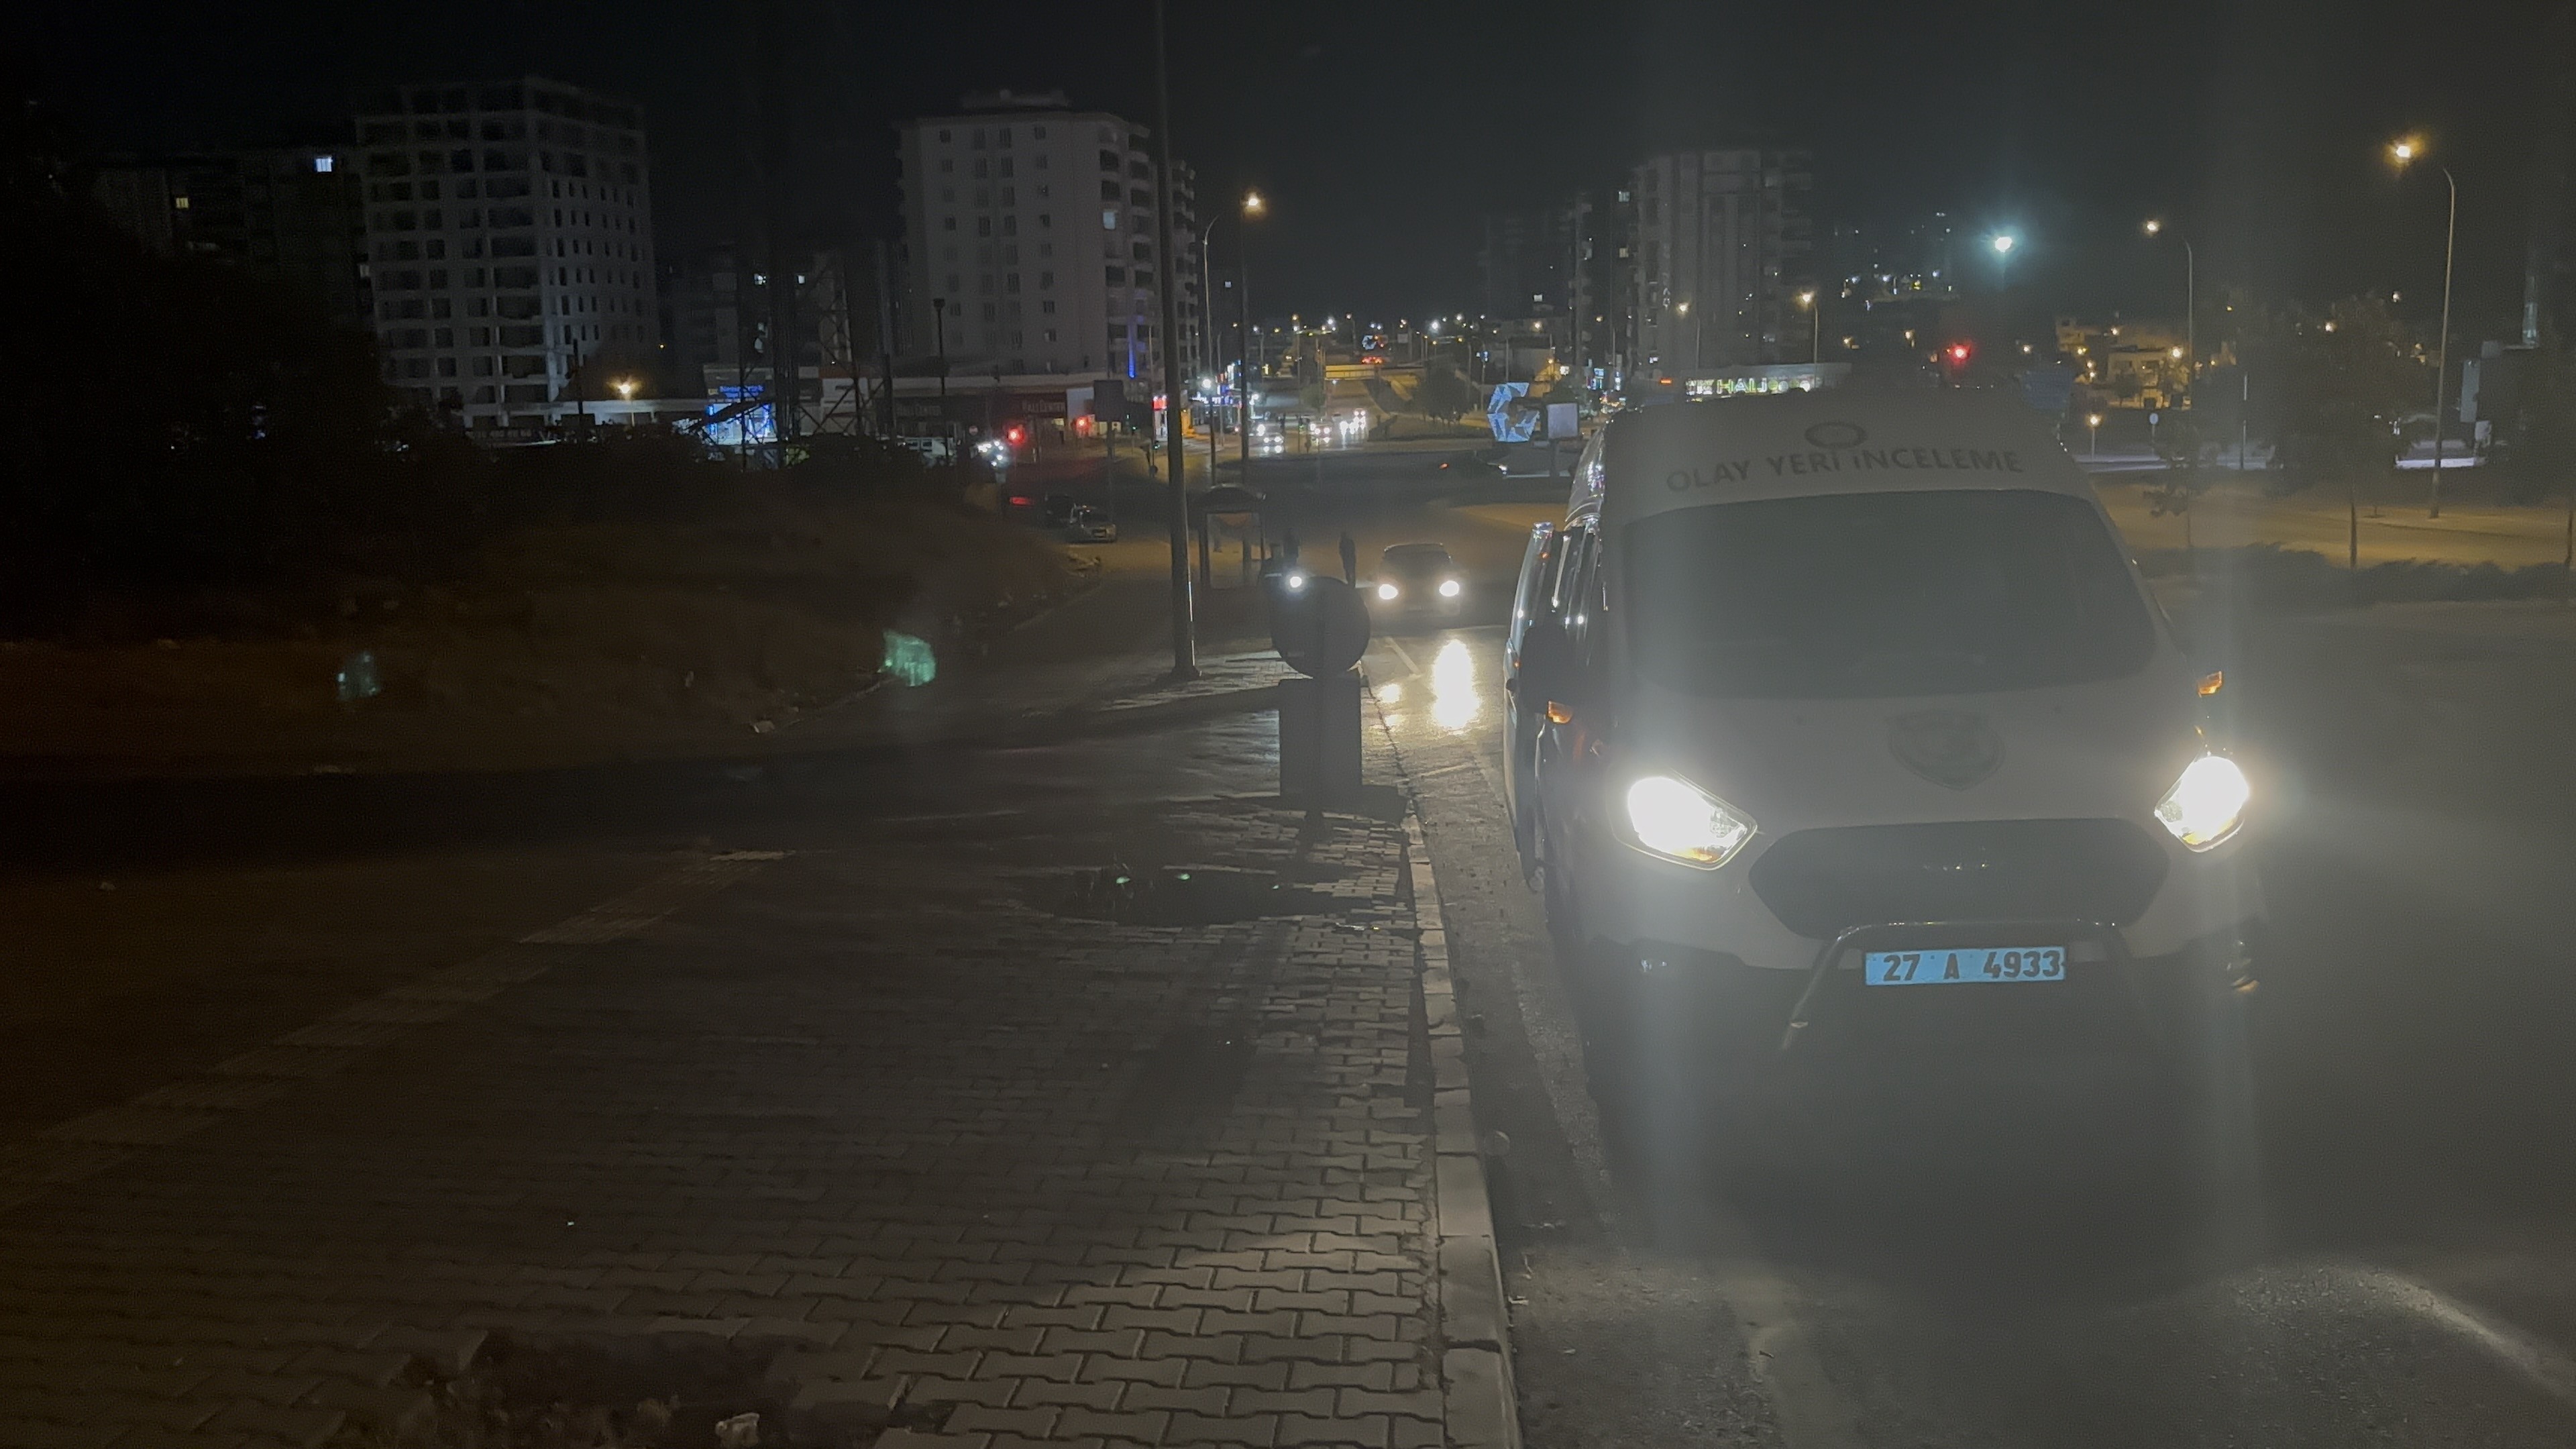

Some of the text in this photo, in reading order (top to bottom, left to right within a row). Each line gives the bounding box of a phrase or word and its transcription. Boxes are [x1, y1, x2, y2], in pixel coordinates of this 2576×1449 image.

[1666, 460, 1751, 492] OLAY
[1882, 950, 2061, 981] 27 A 4933
